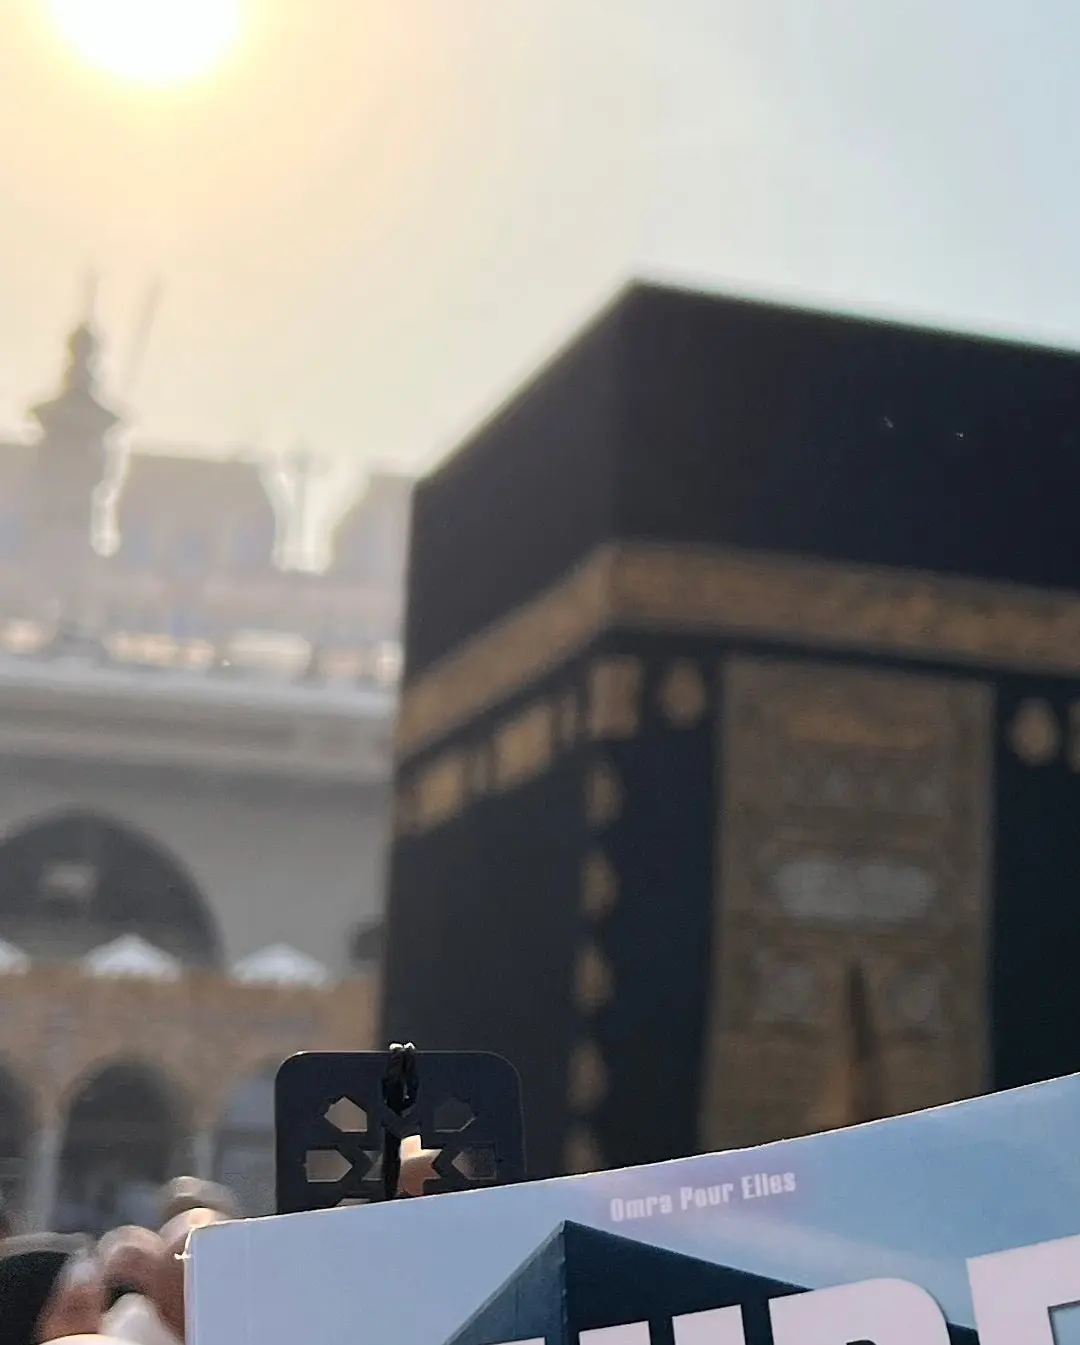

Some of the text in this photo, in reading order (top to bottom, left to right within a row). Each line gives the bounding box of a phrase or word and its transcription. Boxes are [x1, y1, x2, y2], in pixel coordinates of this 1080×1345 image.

[610, 1171, 797, 1223] Omra Pour Elles
